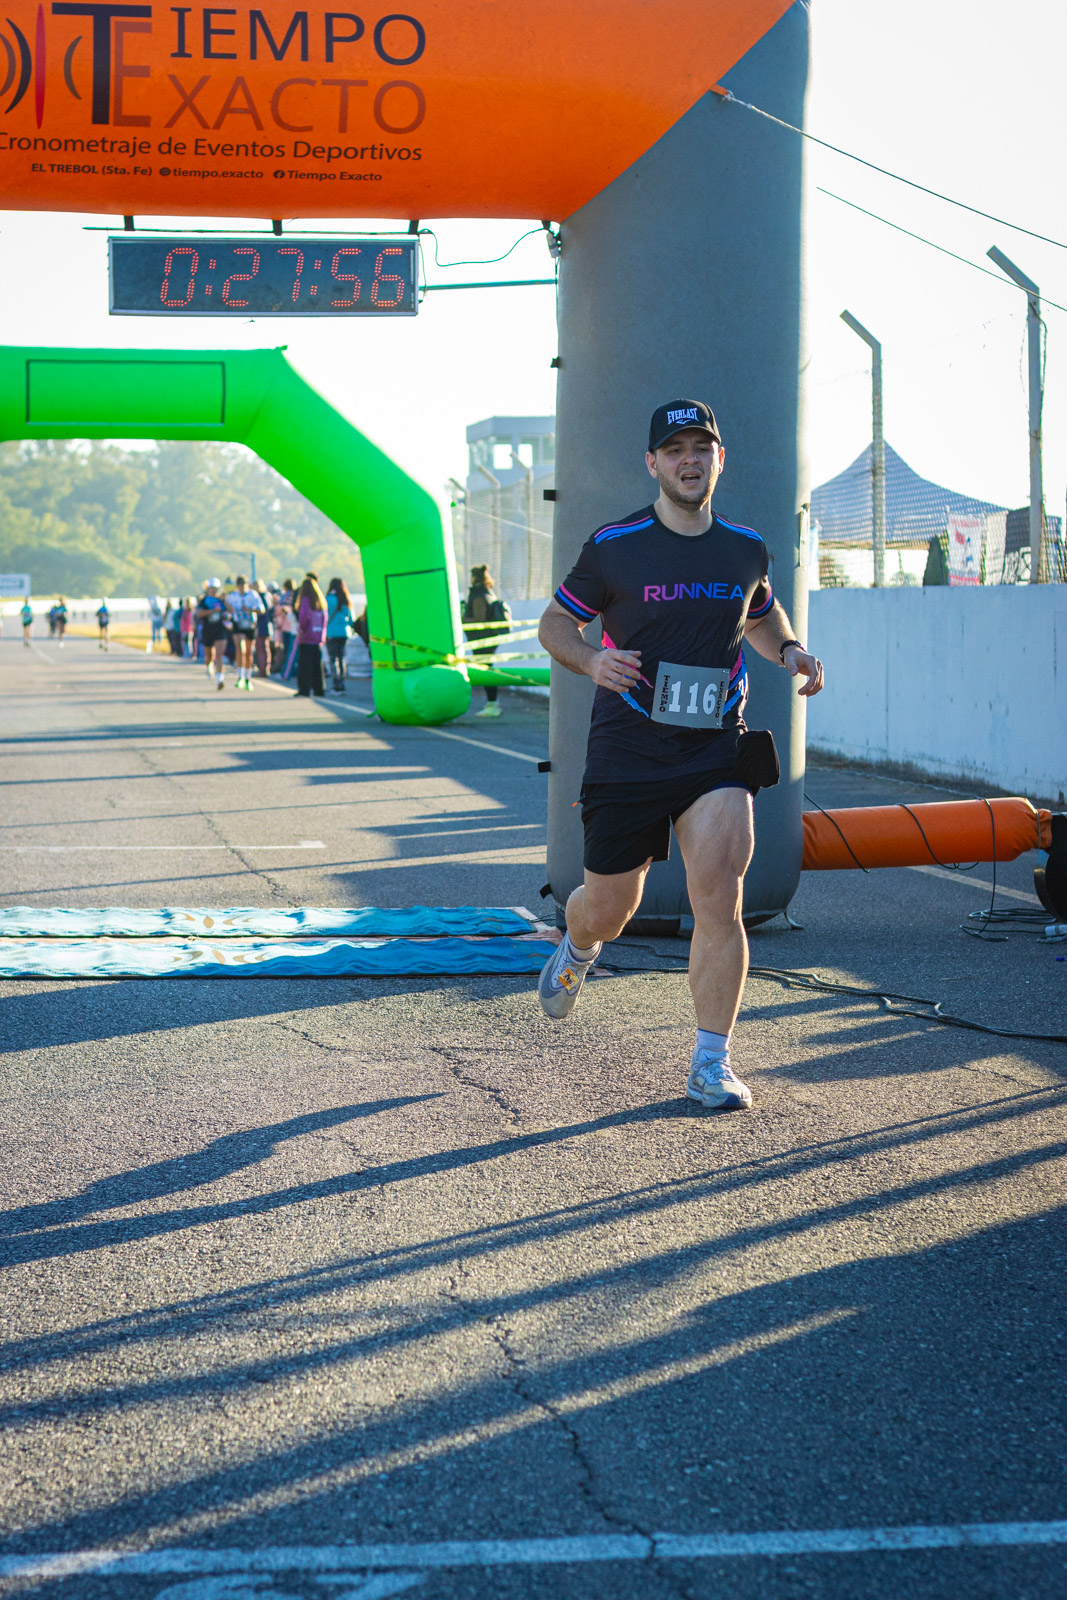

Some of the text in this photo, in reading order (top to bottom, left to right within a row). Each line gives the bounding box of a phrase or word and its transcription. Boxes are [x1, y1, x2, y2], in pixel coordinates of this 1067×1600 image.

[0, 132, 422, 163] Cronometraje de Eventos Deportivos
[31, 163, 153, 176] EL TREBOL (Sta. Fe)
[173, 168, 264, 179] tiempo.exacto
[287, 170, 382, 181] Tiempo Exacto
[160, 248, 405, 308] 0:27:56
[667, 408, 699, 425] EVERLAST
[643, 582, 745, 602] RUNNEA
[659, 675, 670, 712] TIEMPO
[668, 681, 718, 715] 116
[715, 681, 724, 718] EXACTO
